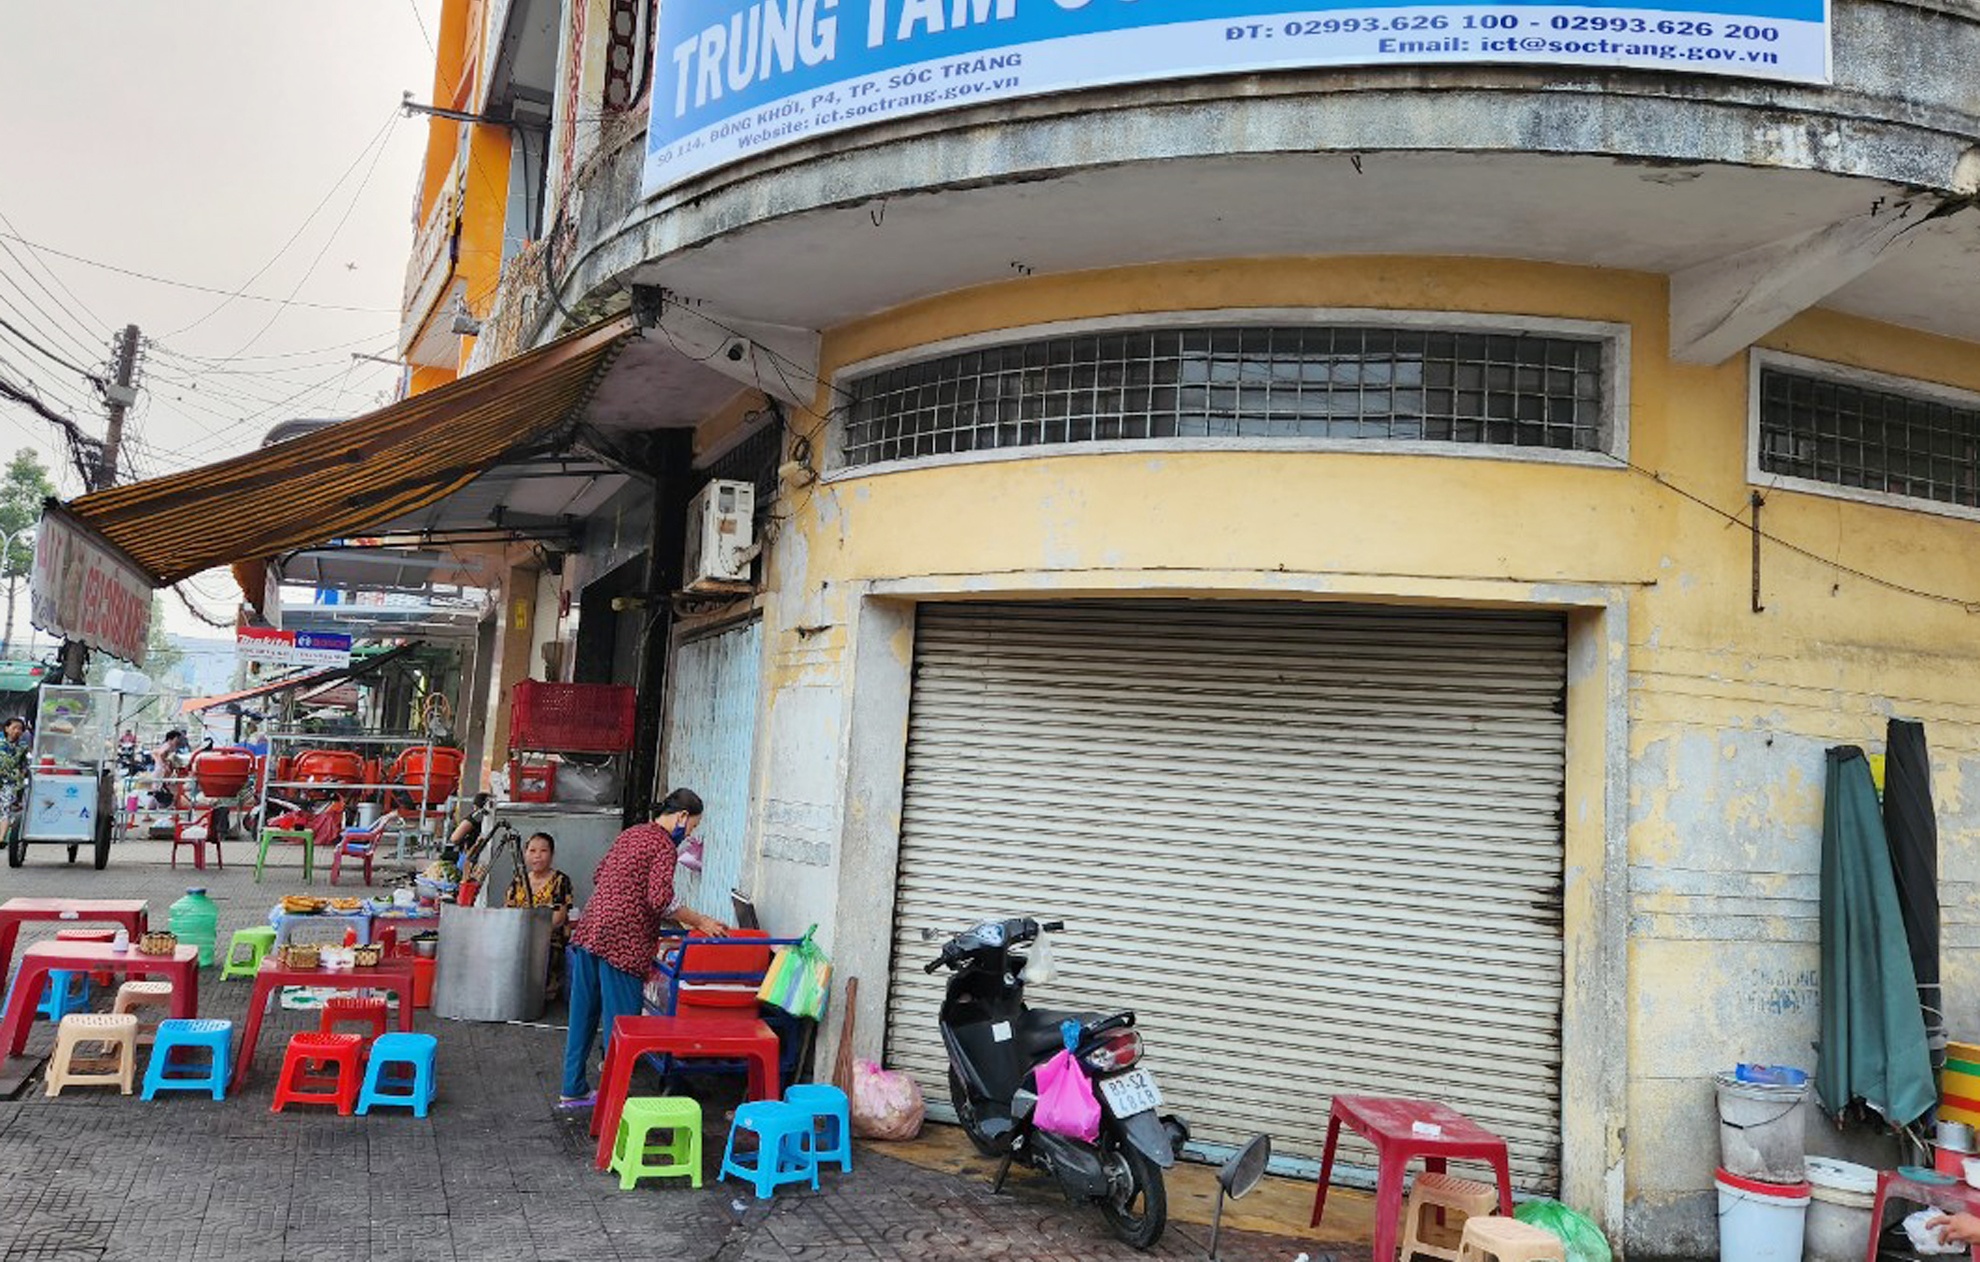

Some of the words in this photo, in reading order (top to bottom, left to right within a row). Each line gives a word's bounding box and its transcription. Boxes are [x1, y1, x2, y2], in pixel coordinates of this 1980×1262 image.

[673, 0, 839, 118] TRUNG
[1226, 24, 1273, 40] ĐT:
[1284, 15, 1449, 36] 02993.626
[1462, 15, 1519, 29] 100
[1551, 15, 1713, 37] 02993.626
[1724, 24, 1779, 41] 200
[1378, 37, 1470, 53] Email:
[1481, 37, 1779, 64] ict@soctrang.gov.vn
[677, 137, 705, 157] 114,
[812, 91, 841, 109] P4,
[849, 81, 881, 98] TP.
[889, 68, 933, 89] SÓC
[738, 119, 809, 149] Website:
[815, 77, 1020, 126] ict.soctrang.gov.vn
